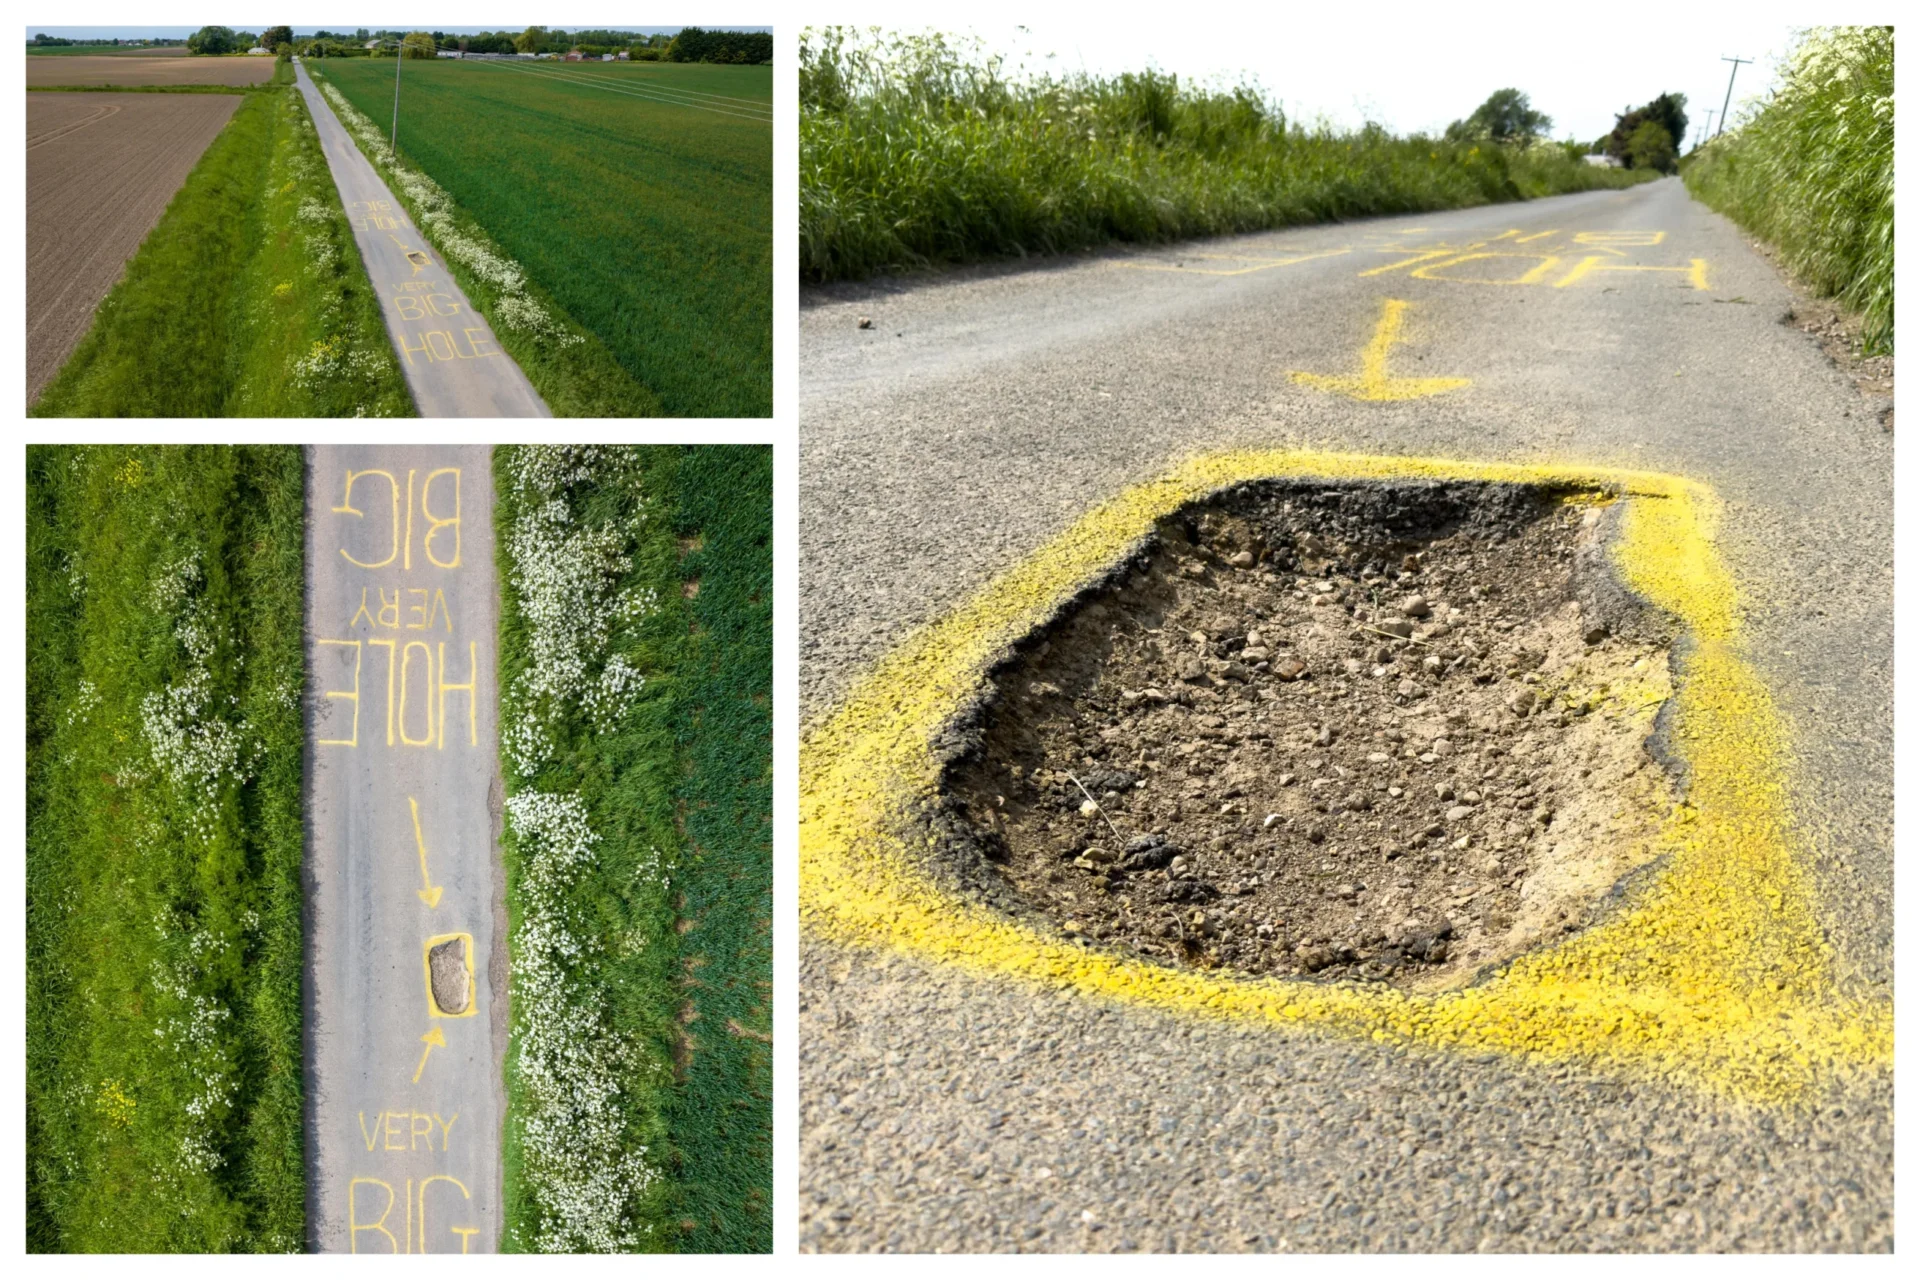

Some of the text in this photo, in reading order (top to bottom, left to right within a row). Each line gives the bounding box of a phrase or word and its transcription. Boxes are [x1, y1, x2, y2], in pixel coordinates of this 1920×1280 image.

[392, 281, 438, 293] VERY
[393, 293, 461, 321] BIG
[398, 328, 500, 366] HOLE
[331, 468, 461, 570] BIG
[351, 586, 452, 633] VERY
[318, 638, 477, 751] HOLE
[358, 1110, 458, 1151] VERY
